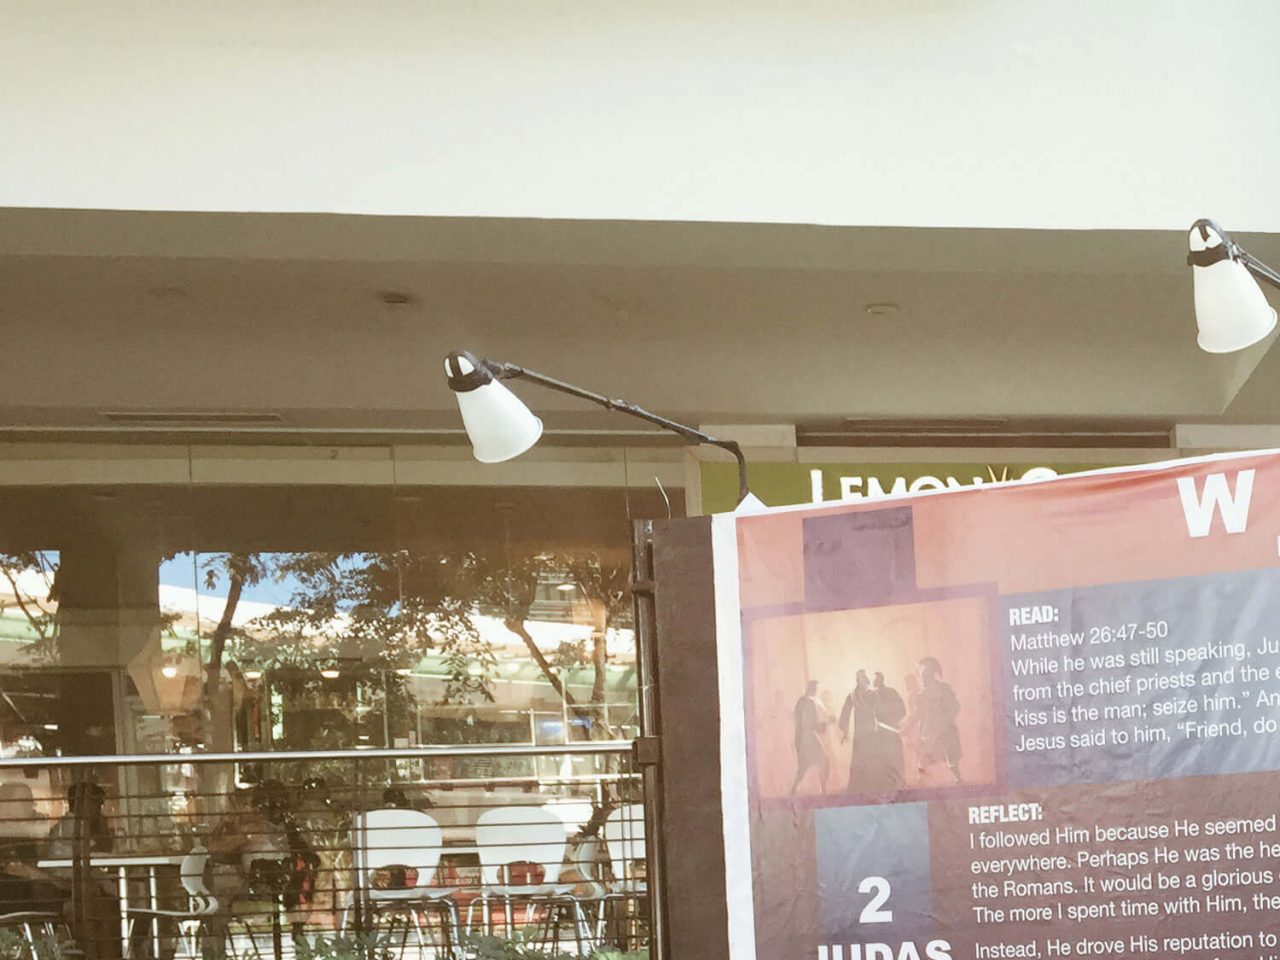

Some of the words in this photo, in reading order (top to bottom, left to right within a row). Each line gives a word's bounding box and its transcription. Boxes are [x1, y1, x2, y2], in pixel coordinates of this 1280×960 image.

[1009, 606, 1059, 626] READ:
[1011, 631, 1084, 651] Matthew
[1090, 620, 1168, 644] 26:47-50
[1011, 657, 1058, 676] While
[1064, 656, 1085, 671] he
[1090, 654, 1125, 669] was
[1130, 647, 1159, 666] still
[1165, 641, 1251, 666] speaking,
[968, 803, 1042, 824] REFLECT:
[979, 828, 1050, 848] followed
[1056, 826, 1090, 844] Him
[1095, 825, 1169, 842] because
[1174, 820, 1200, 837] He
[1204, 814, 1276, 835] seemed
[858, 876, 893, 924] 2
[972, 906, 1004, 923] The
[1010, 907, 1052, 922] more
[1067, 901, 1116, 922] spent
[1120, 899, 1159, 916] time
[1164, 896, 1200, 914] with
[1206, 894, 1247, 914] Him,
